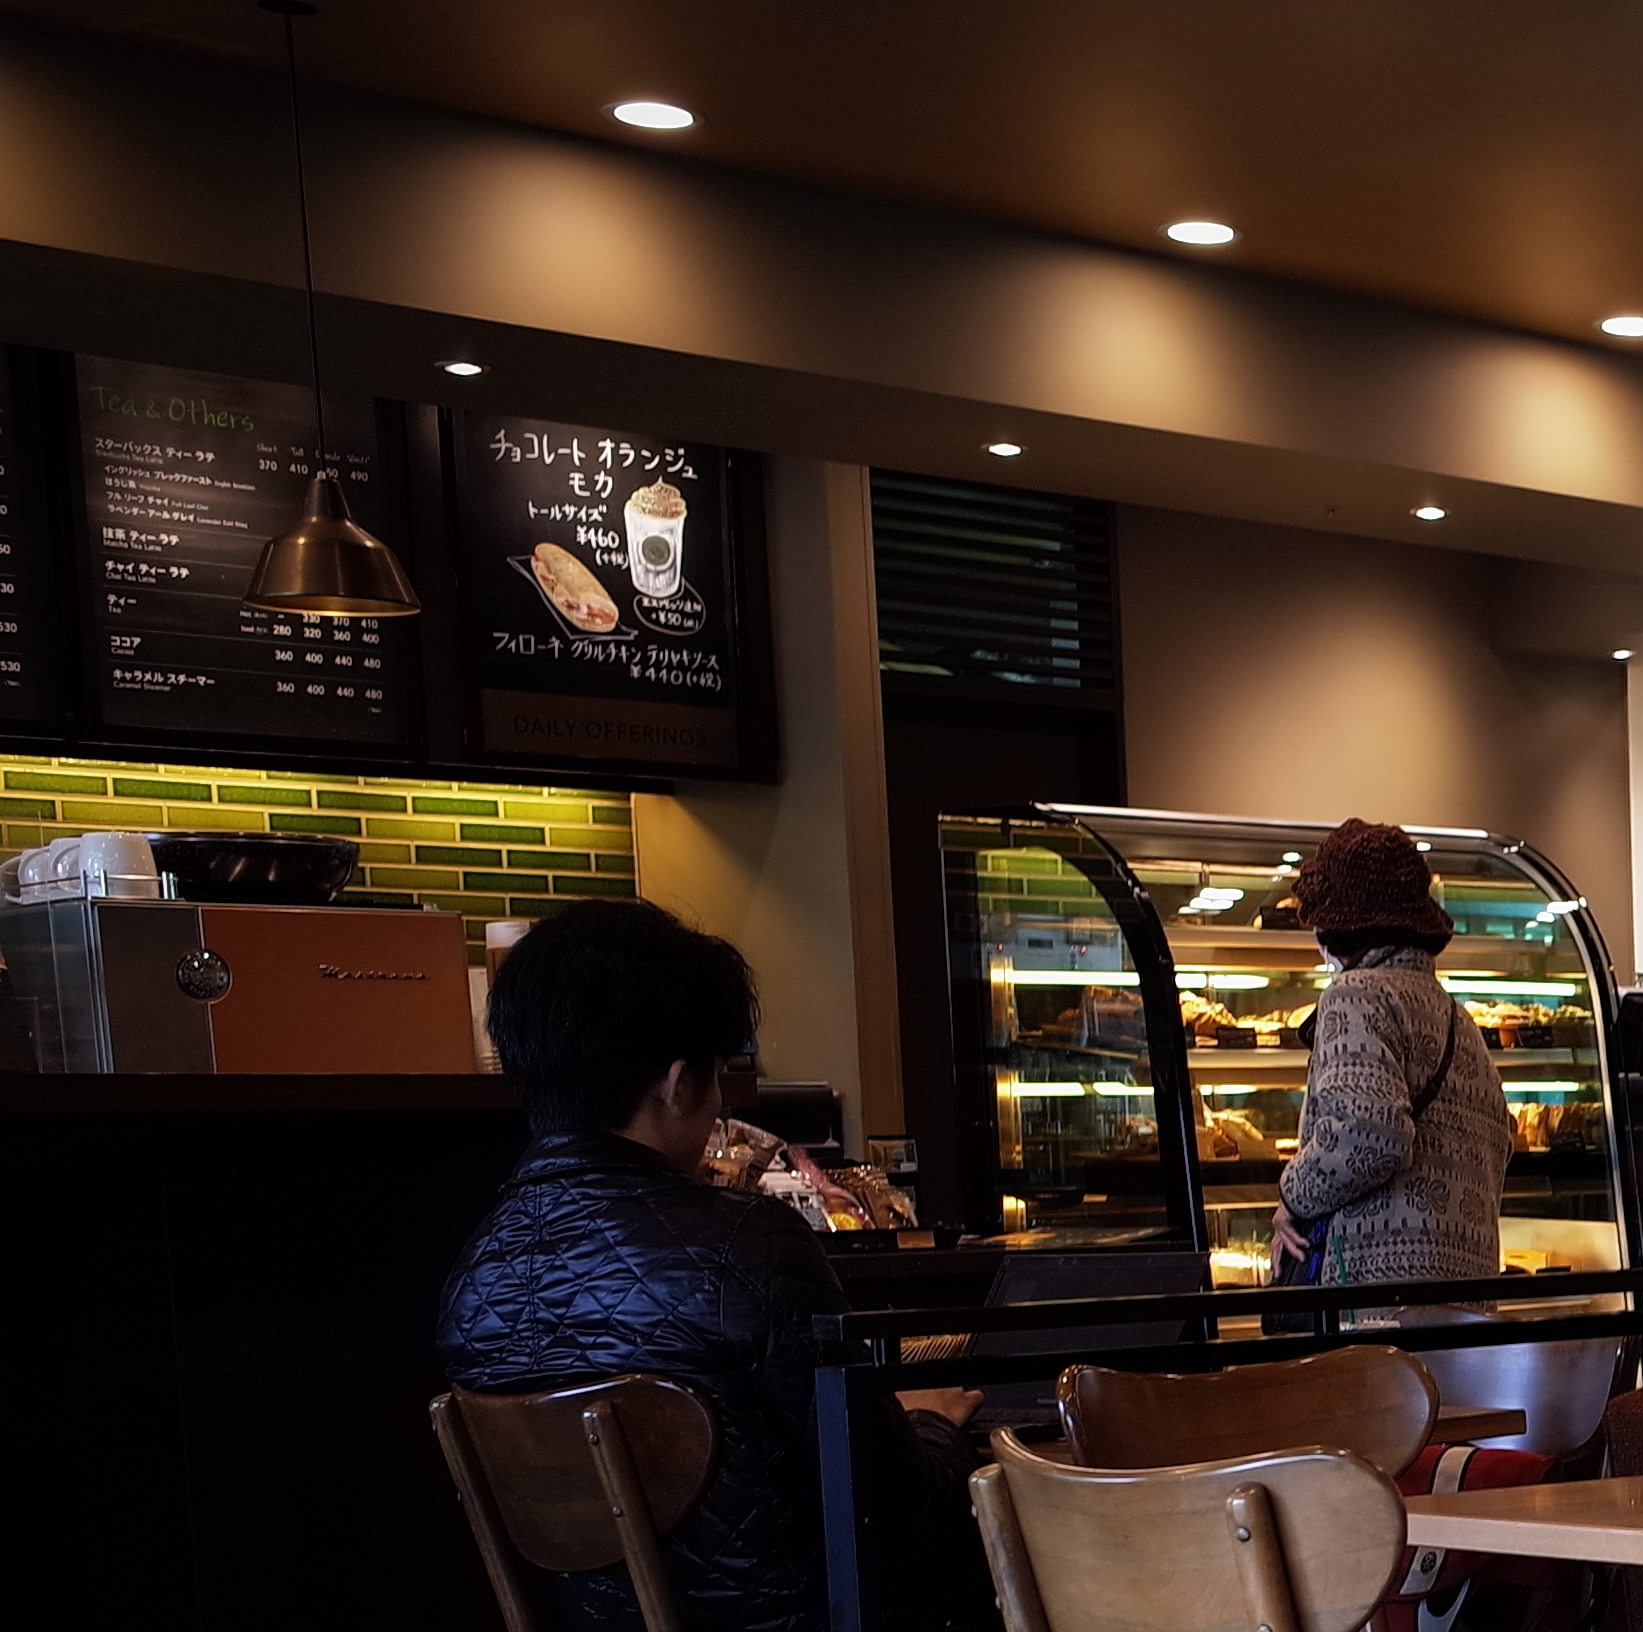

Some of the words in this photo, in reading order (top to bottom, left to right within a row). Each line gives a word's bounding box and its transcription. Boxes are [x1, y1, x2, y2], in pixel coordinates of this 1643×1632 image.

[90, 386, 139, 417] Tea
[146, 401, 161, 419] &
[169, 398, 255, 431] Others
[95, 437, 163, 457] スターバックス
[166, 447, 193, 460] ティー
[195, 450, 216, 464] ラテ
[315, 449, 340, 461] Gande
[489, 428, 586, 467] チョコレート
[597, 437, 699, 480] オランジュ
[259, 459, 279, 471] 370
[289, 463, 309, 475] 410
[350, 470, 369, 482] 490
[568, 469, 614, 499] モカ
[527, 499, 608, 523] トールサイズ
[128, 530, 157, 543] ティー
[158, 533, 181, 547] ラテ
[575, 524, 621, 550] ¥460
[104, 559, 136, 574] チャイ
[138, 563, 168, 577] ティー
[169, 565, 191, 580] ラテ
[106, 593, 138, 607] ティー
[273, 624, 293, 637] 280
[303, 627, 323, 639] 320
[333, 630, 352, 642] 360
[361, 633, 380, 645] 400
[361, 619, 379, 630] 410
[110, 635, 142, 649] ココア
[492, 631, 564, 660] フィローネ
[570, 640, 642, 664] グリルチキン
[275, 649, 295, 662] 360
[305, 652, 324, 665] 400
[334, 655, 353, 667] 440
[363, 658, 382, 670] 480
[112, 668, 165, 683] キャラメル
[166, 673, 216, 687] スチーマー
[276, 681, 296, 694] 360
[306, 684, 326, 696] 400
[336, 686, 355, 698] 440
[365, 689, 383, 701] 480
[513, 715, 577, 737] DAILY
[585, 721, 708, 747] OFFERINGS
